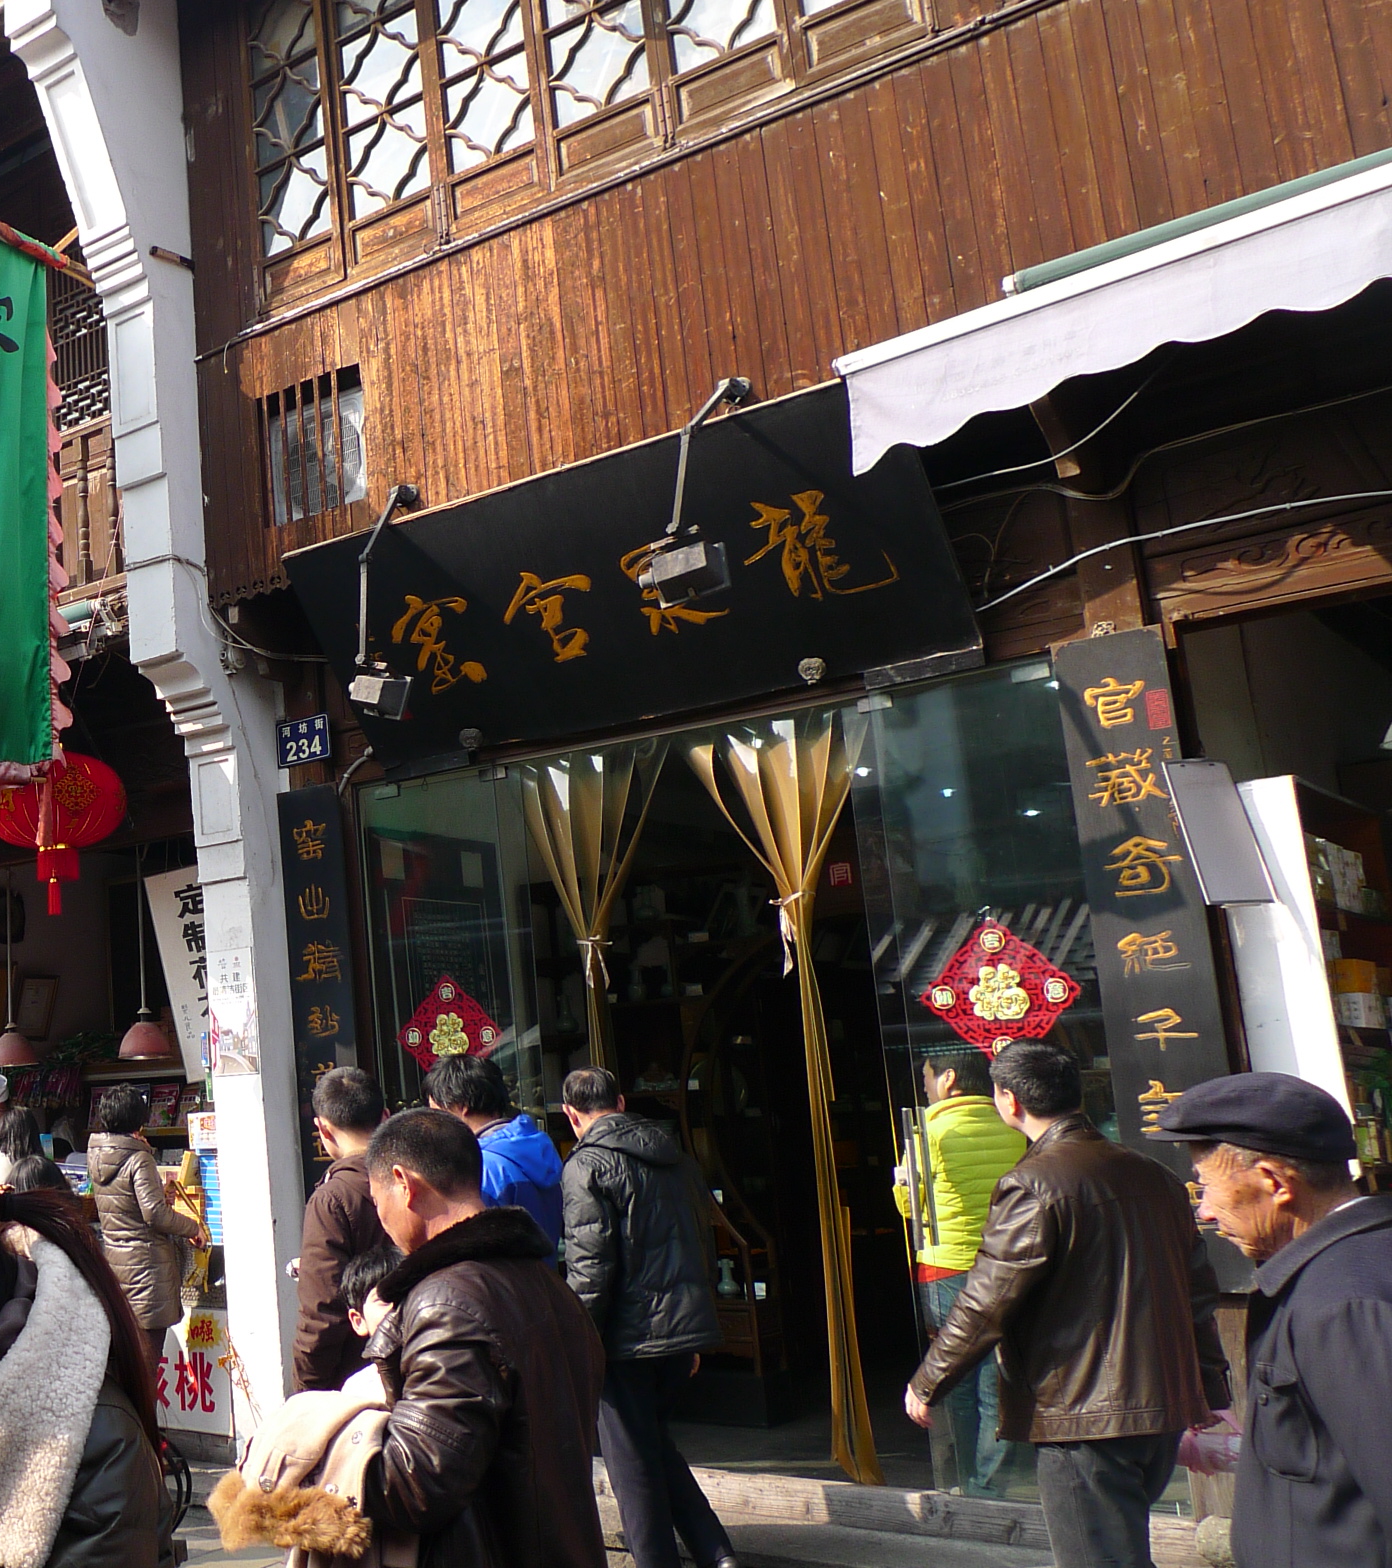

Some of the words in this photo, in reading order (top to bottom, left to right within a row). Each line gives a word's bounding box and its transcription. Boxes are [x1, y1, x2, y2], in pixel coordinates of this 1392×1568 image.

[282, 718, 324, 738] 河坊街
[286, 735, 322, 762] 234
